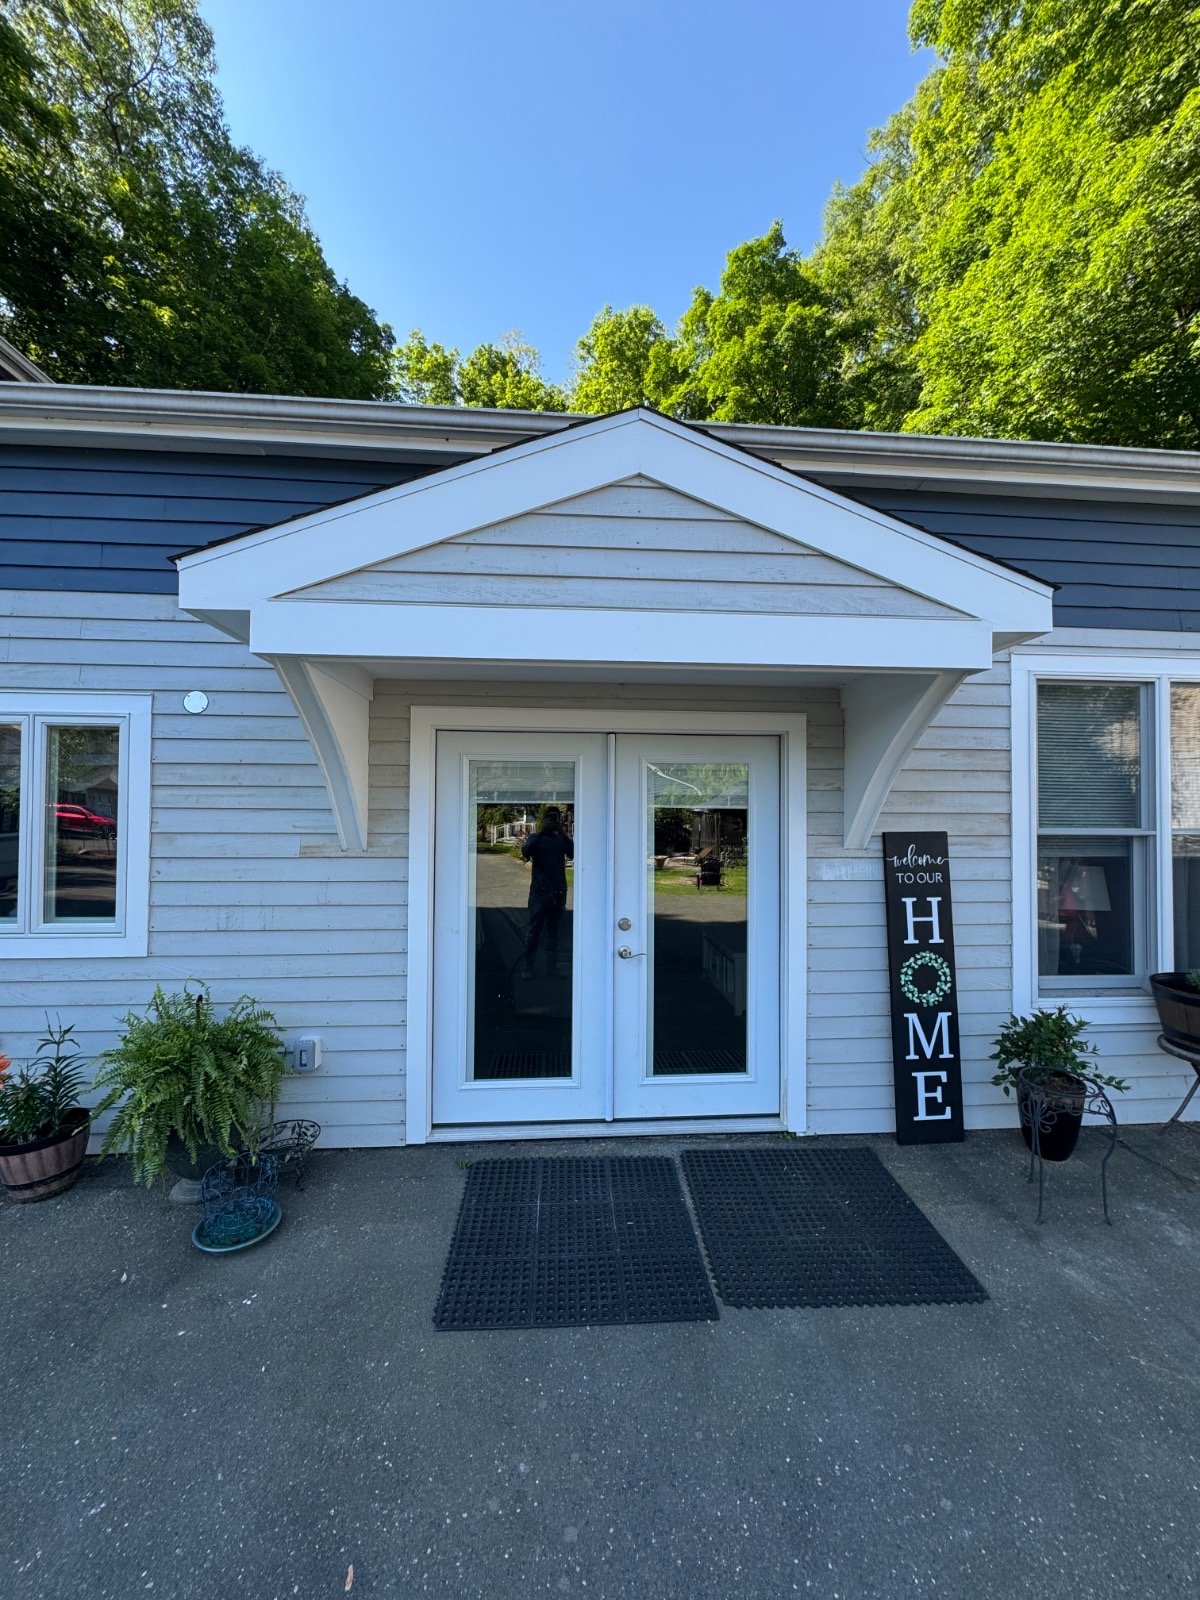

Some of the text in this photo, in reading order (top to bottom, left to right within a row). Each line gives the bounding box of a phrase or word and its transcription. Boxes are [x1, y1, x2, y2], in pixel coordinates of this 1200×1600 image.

[887, 844, 949, 868] welcome
[896, 872, 943, 884] TO OUR
